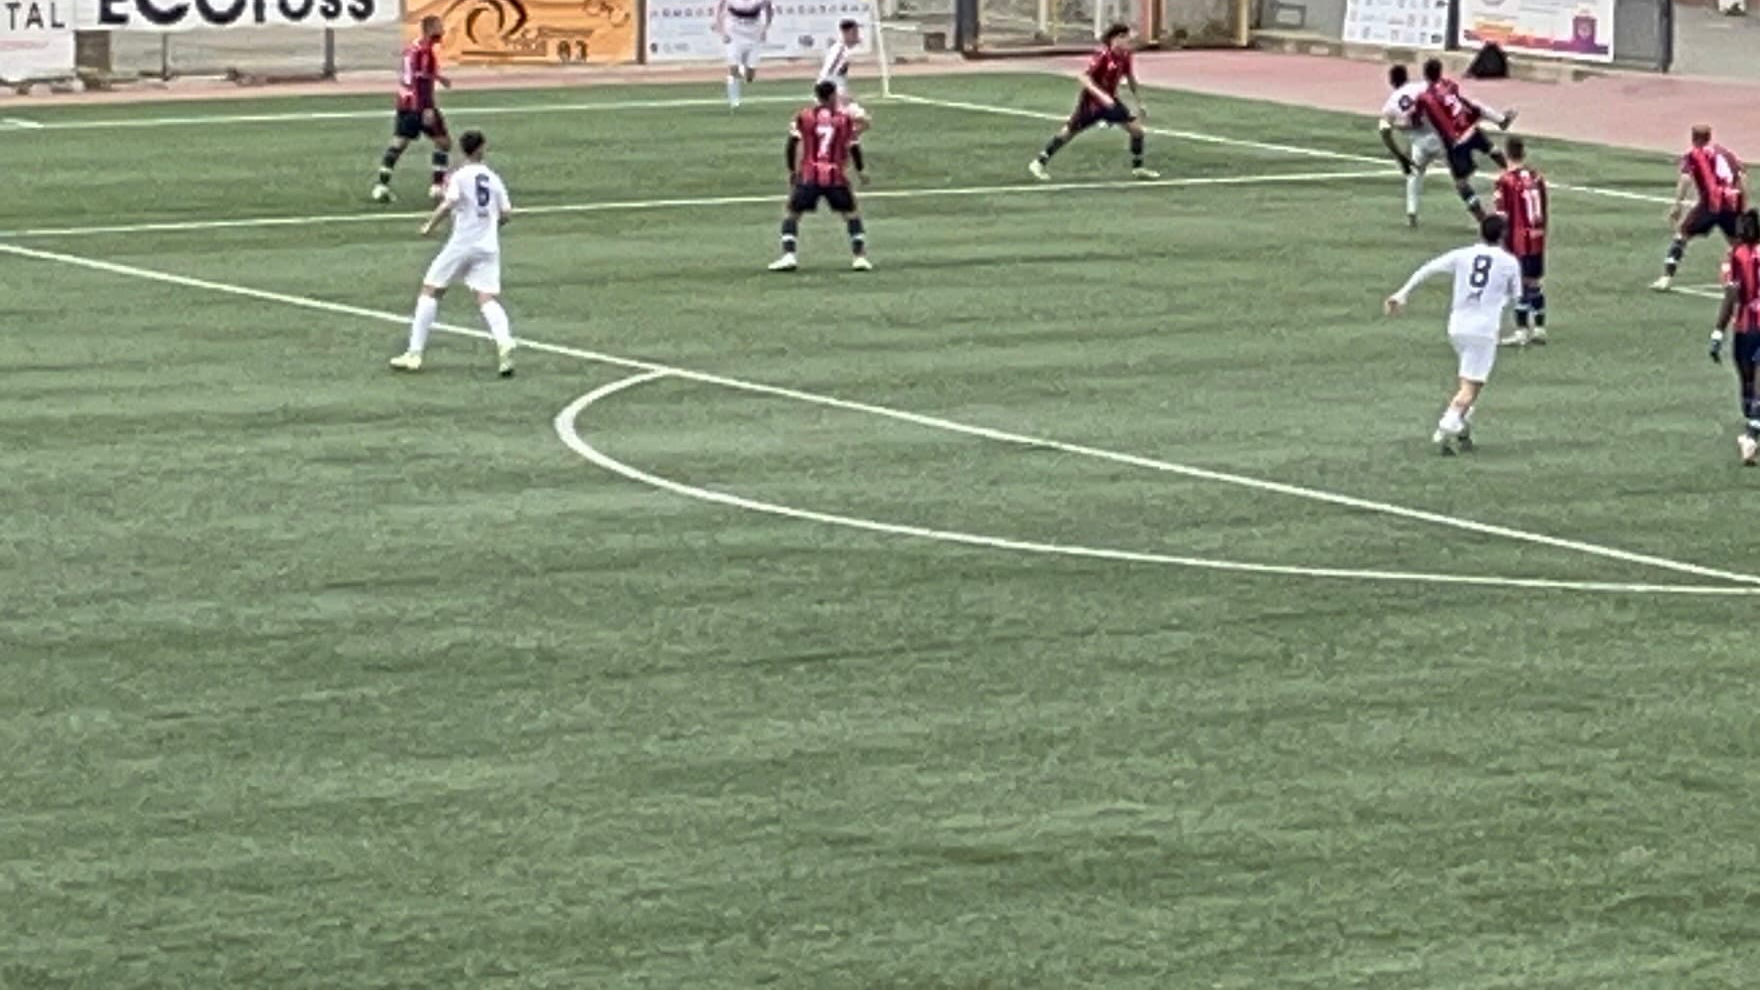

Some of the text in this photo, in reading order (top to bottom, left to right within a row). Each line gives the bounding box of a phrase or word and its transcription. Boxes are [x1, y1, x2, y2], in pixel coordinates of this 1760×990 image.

[5, 1, 65, 31] TAL
[815, 124, 835, 159] 7
[475, 172, 490, 208] 6
[1469, 254, 1493, 288] 8
